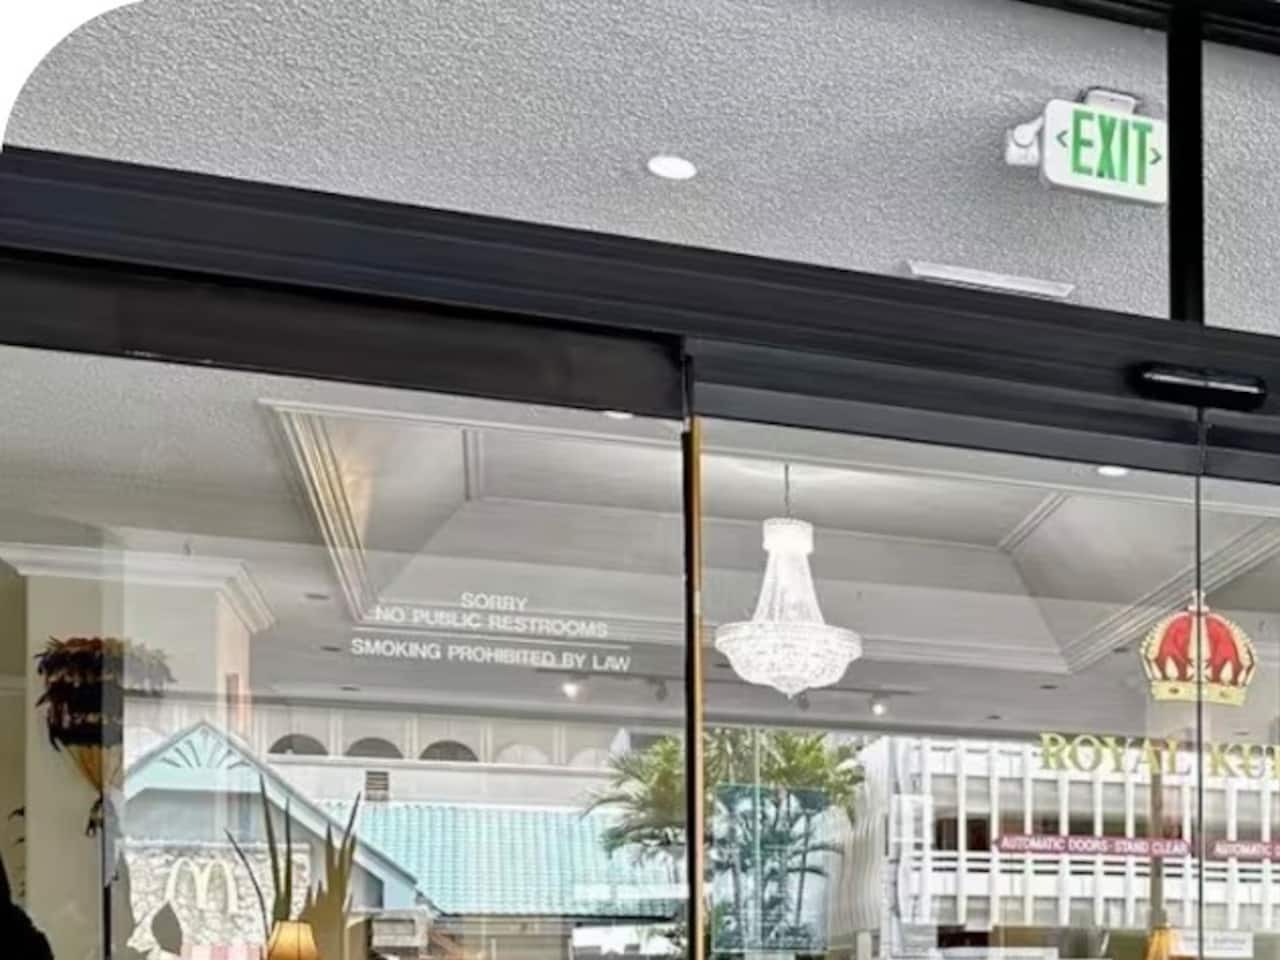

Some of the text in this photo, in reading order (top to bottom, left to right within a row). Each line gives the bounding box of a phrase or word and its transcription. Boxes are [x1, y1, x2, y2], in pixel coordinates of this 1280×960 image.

[1072, 108, 1153, 186] EXIT
[460, 591, 528, 611] SORRY
[375, 605, 609, 638] NO PUBLIC RESTROOMS
[350, 638, 632, 672] SMOKING PROHIBITED BY LAW
[1038, 731, 1193, 776] ROYAL
[1001, 834, 1066, 851] AUTOMATIC
[1152, 842, 1189, 856] CLEAR
[1215, 841, 1272, 857] AUTOMATIC
